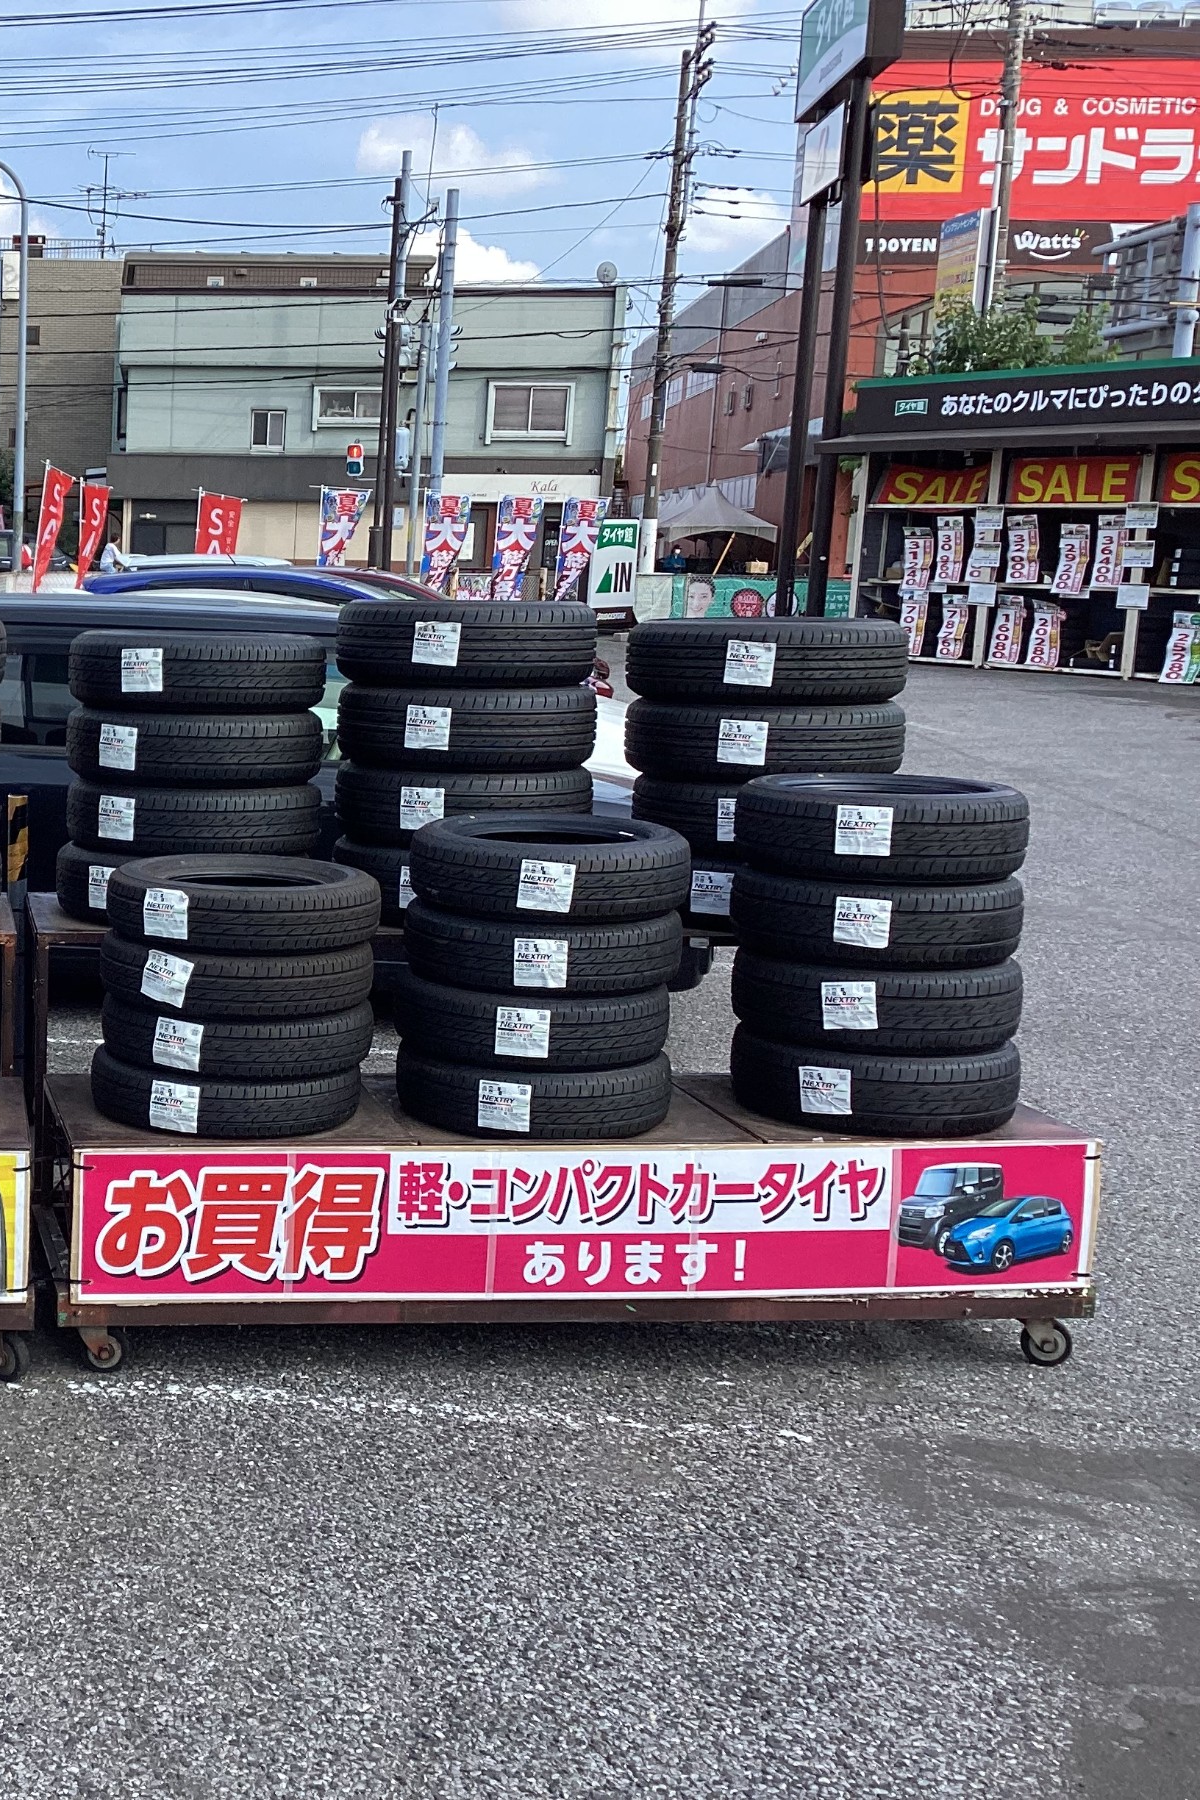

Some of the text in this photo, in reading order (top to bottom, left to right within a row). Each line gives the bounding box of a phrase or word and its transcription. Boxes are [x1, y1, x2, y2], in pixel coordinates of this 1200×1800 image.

[979, 97, 1198, 117] DUG & COSMETIC
[877, 99, 961, 185] 薬
[976, 127, 1200, 186] サンドラ
[1013, 231, 1081, 250] Watts
[530, 480, 558, 493] Kala
[888, 468, 988, 503] SALE
[1017, 463, 1131, 502] SALE
[602, 527, 633, 543] タイヤ館
[612, 562, 633, 593] IN
[416, 631, 447, 641] NEXTRY
[729, 652, 762, 661] NEXTRY
[408, 717, 438, 726] NEXTRY
[721, 731, 753, 740] NEXTRY
[402, 798, 432, 808] NEXTRY
[838, 819, 879, 829] NEXTRY
[523, 873, 559, 884] NEXTRY
[694, 882, 725, 892] NEXTRY
[146, 901, 175, 911] NEXTRY
[837, 911, 878, 921] NEXTRY
[517, 952, 553, 961] NEXTRY
[148, 961, 176, 979] NEXTRY
[824, 995, 863, 1004] NEXTRY
[500, 1020, 536, 1030] NEXTRY
[158, 1032, 188, 1044] NEXTRY
[801, 1079, 839, 1091] NEXTRY
[153, 1094, 184, 1106] NEXTRY
[482, 1094, 516, 1105] NEXTRY
[398, 1159, 884, 1225] 軽・コンパクトカータイヤ
[98, 1168, 382, 1278] お買得
[521, 1239, 747, 1287] あります！
